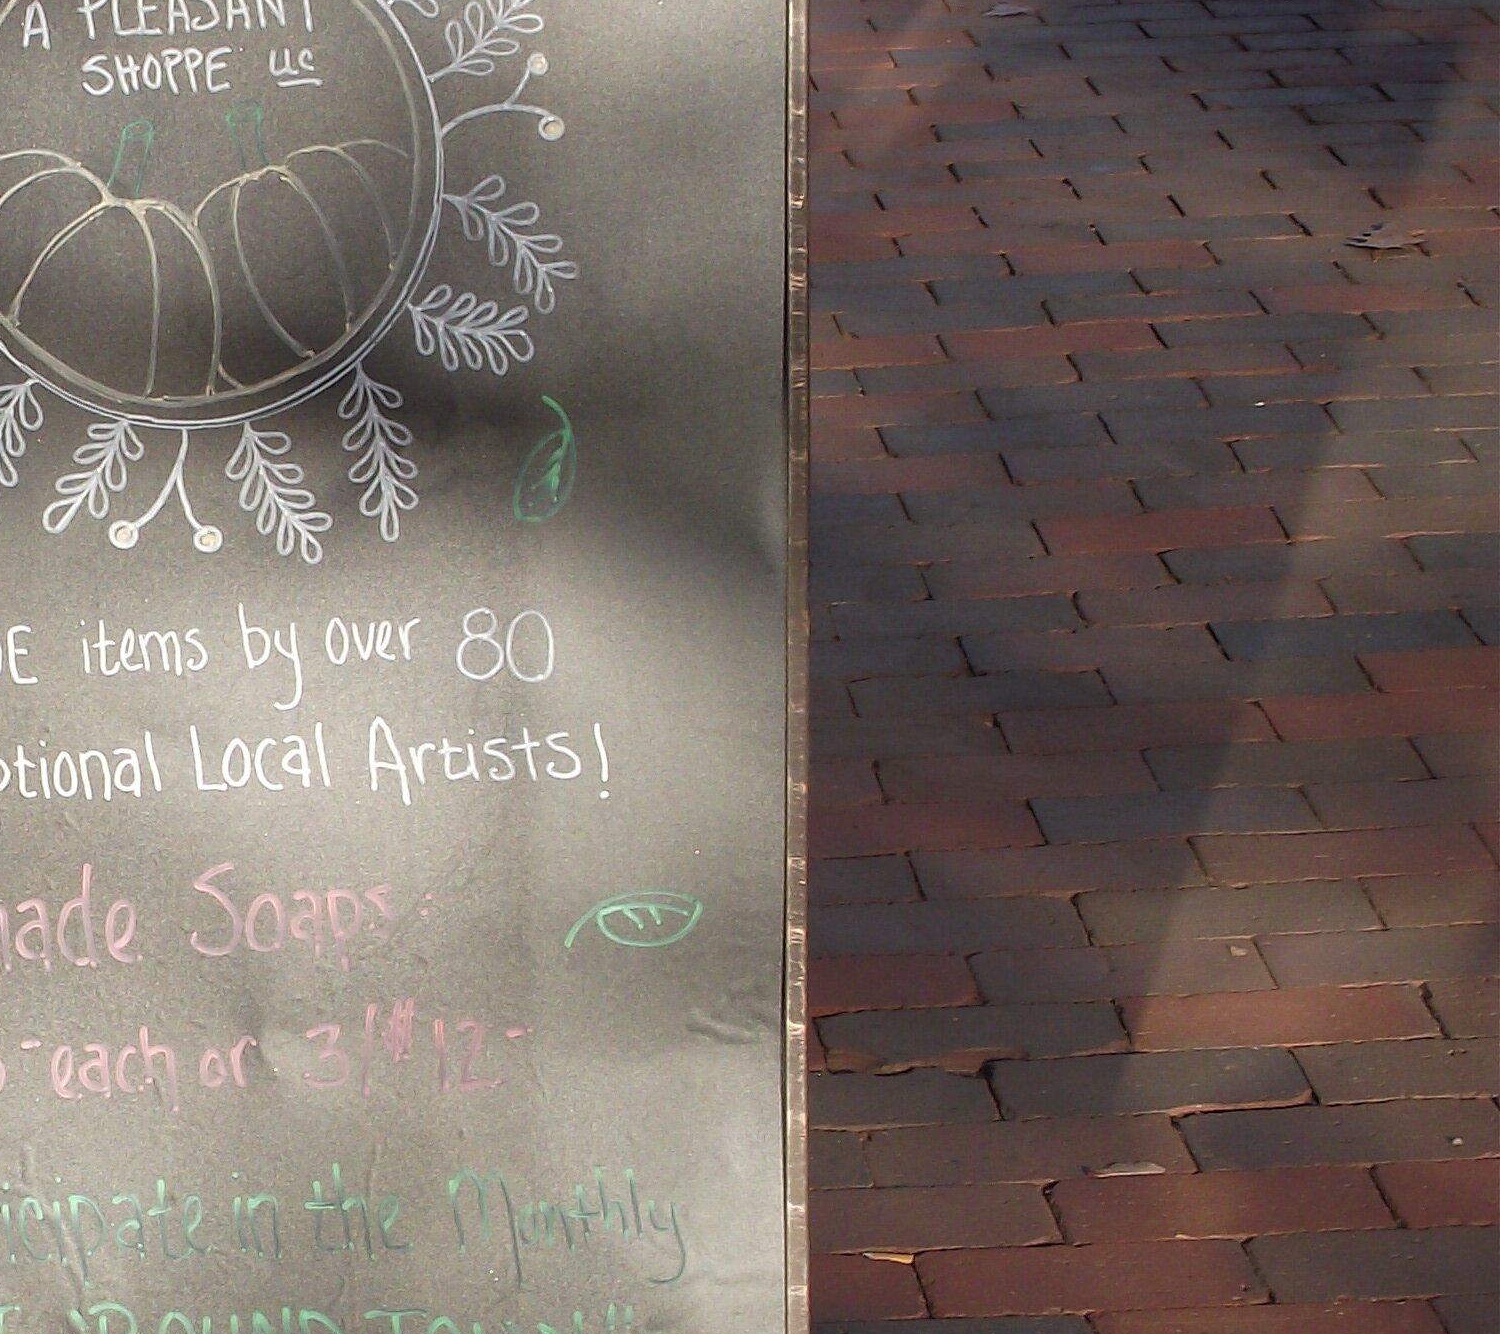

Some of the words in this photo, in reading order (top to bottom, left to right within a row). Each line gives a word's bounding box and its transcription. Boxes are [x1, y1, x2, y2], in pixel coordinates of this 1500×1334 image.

[22, 0, 52, 51] A
[81, 47, 233, 97] SHOPPE
[80, 619, 208, 676] items
[238, 603, 303, 710] by
[324, 617, 420, 666] over
[456, 607, 554, 683] 80
[189, 722, 331, 791] Local
[368, 716, 610, 805] Artists!
[200, 1035, 257, 1088] or
[233, 1171, 284, 1260] in
[304, 1162, 414, 1261] the
[448, 1165, 687, 1289] Monthly
